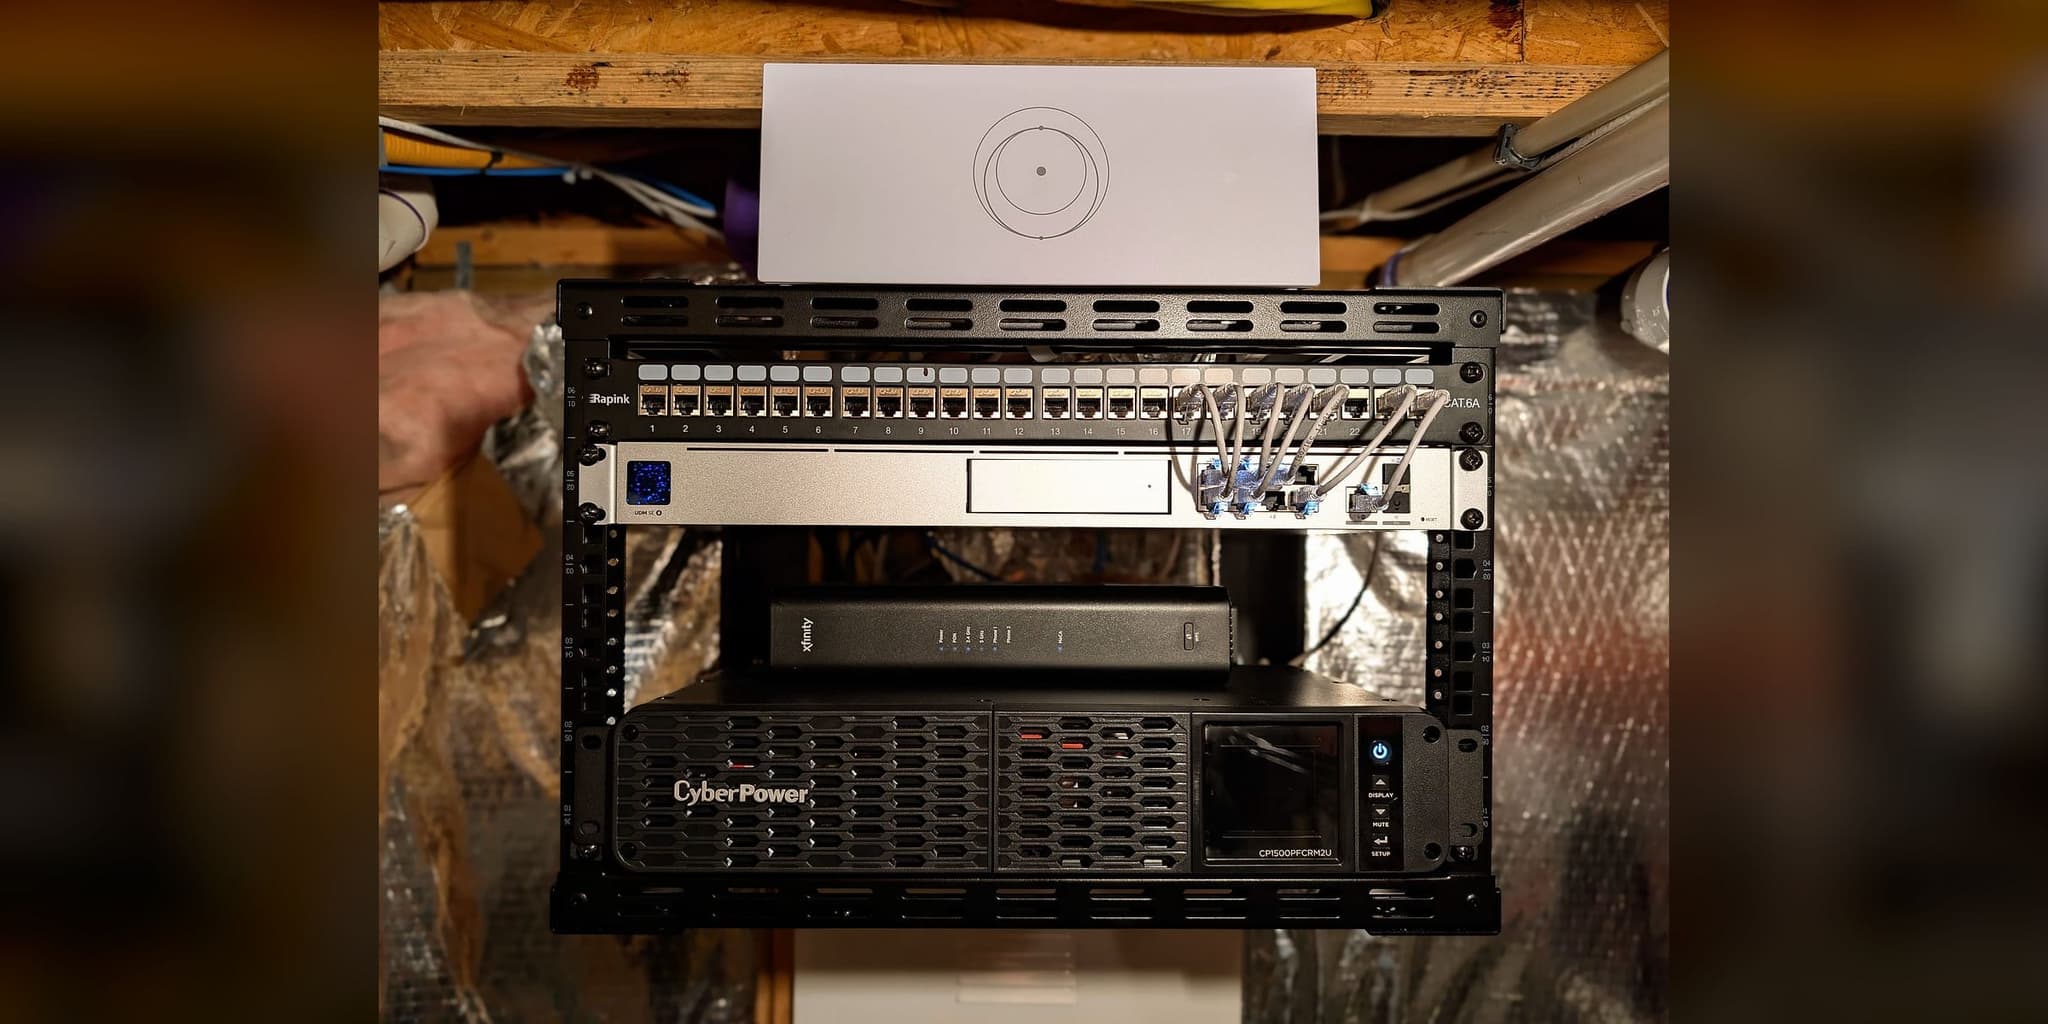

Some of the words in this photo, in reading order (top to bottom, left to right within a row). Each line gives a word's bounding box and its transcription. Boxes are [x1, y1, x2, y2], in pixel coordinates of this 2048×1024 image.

[590, 393, 630, 406] Rapink
[650, 424, 655, 433] 1
[682, 424, 689, 433] 2
[715, 424, 722, 433] 3
[749, 425, 755, 433] 4
[782, 425, 789, 434] 5
[815, 425, 822, 434] 6
[853, 426, 859, 434] 7
[885, 426, 892, 435] 8
[918, 426, 924, 435] 9
[949, 427, 959, 435] 10
[982, 427, 991, 435] 11
[1014, 427, 1024, 436] 12
[1050, 427, 1061, 436] 13
[1083, 427, 1093, 435] 14
[1116, 427, 1126, 436] 15
[1149, 427, 1159, 436] 16
[1182, 428, 1191, 436] 17
[1350, 427, 1360, 436] 22
[801, 617, 814, 652] xfinity
[673, 779, 809, 806] CyberPower
[1258, 848, 1333, 857] CP1500PFCRM2U
